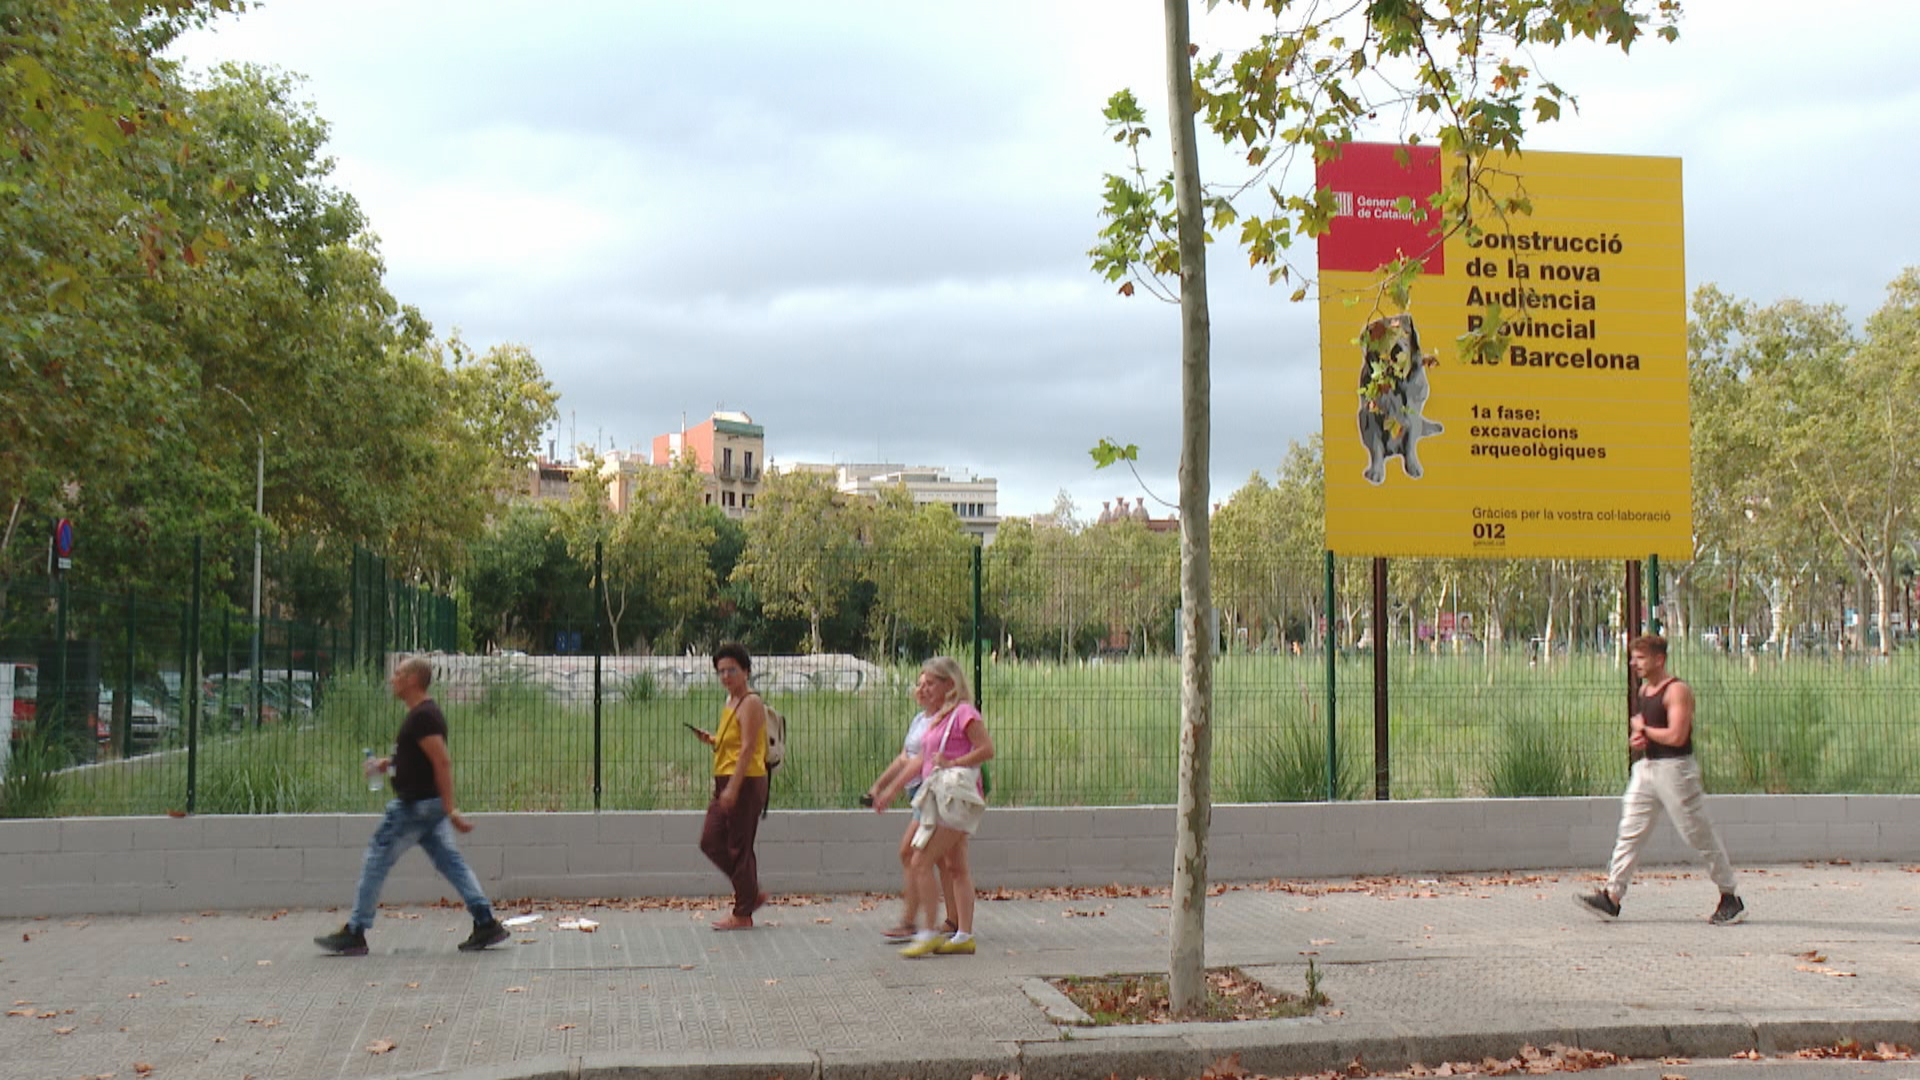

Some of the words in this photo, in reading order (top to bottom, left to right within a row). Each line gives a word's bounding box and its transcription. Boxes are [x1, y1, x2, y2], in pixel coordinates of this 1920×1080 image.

[1357, 207, 1372, 219] de
[1466, 257, 1497, 278] de
[1508, 258, 1529, 279] la
[1540, 264, 1600, 282] nova
[1466, 286, 1596, 310] Audiència
[1468, 315, 1596, 340] Povincial
[1510, 345, 1640, 371] Barcelona
[1471, 404, 1491, 419] 1a
[1497, 405, 1541, 421] fase:
[1470, 424, 1578, 440] excavacions
[1470, 442, 1607, 461] arqueològiques
[1472, 506, 1517, 519] Gràcies
[1521, 510, 1540, 521] per
[1543, 508, 1554, 520] la
[1557, 509, 1593, 520] vostra
[1473, 523, 1505, 539] 012
